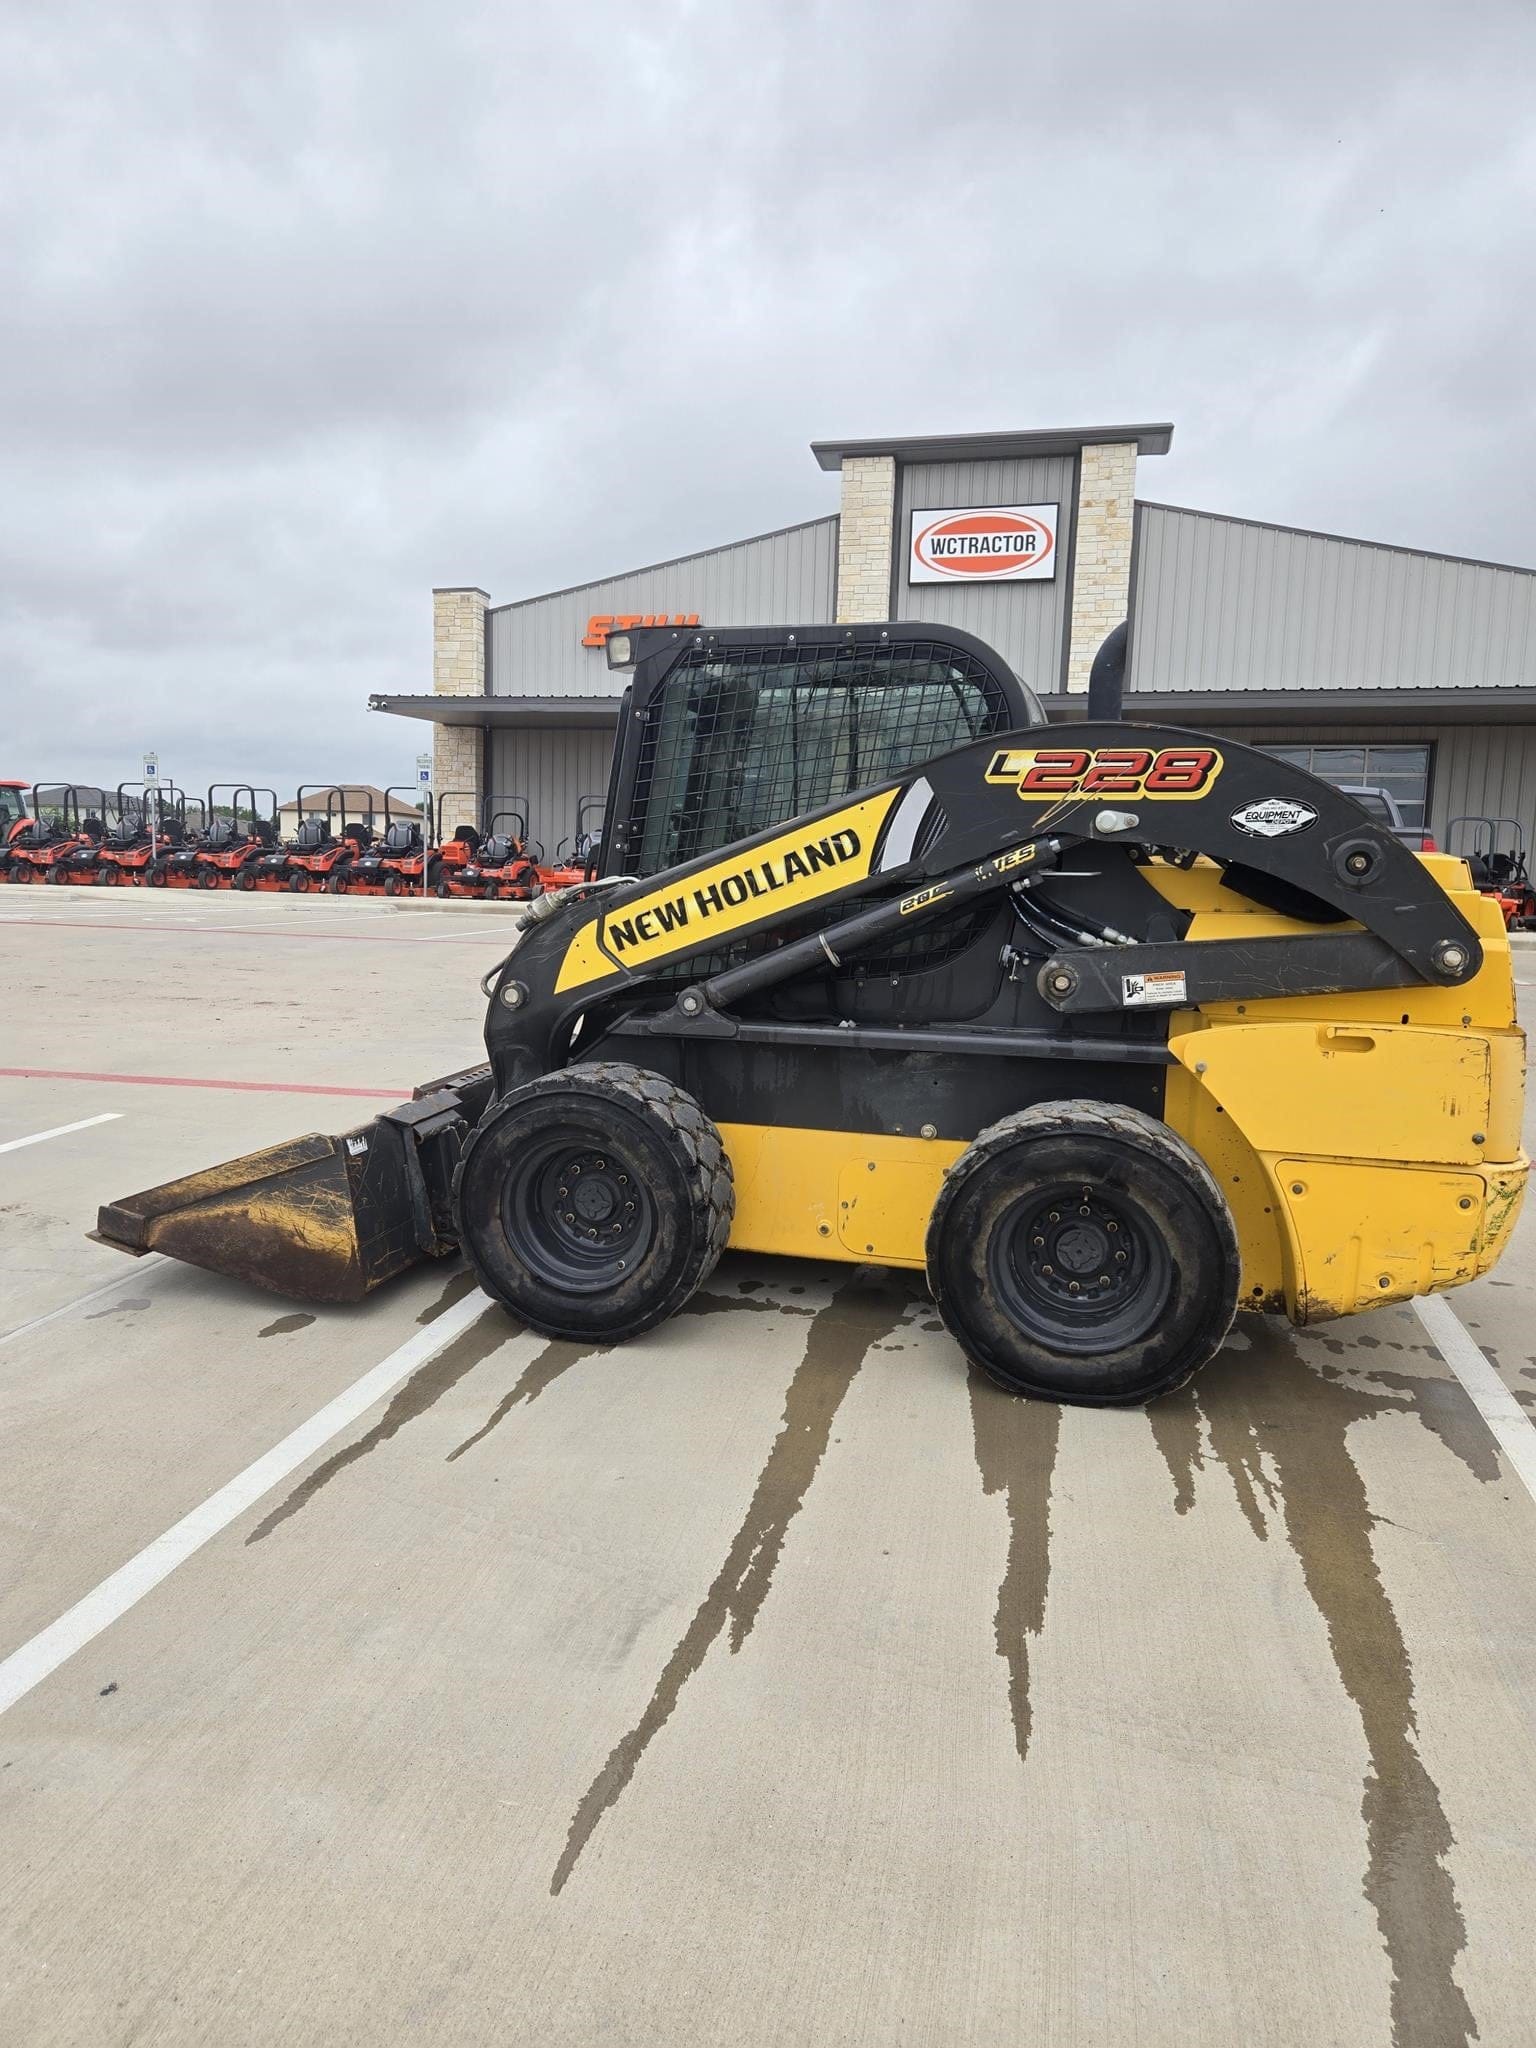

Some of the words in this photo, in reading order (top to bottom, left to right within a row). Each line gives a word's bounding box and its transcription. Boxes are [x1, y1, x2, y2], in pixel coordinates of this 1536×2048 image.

[931, 534, 1036, 555] WCTRACTOR
[987, 750, 1220, 796] L228
[1245, 810, 1302, 821] EQUIPMENT
[608, 896, 689, 951] NEW
[693, 828, 862, 918] HOLLAND
